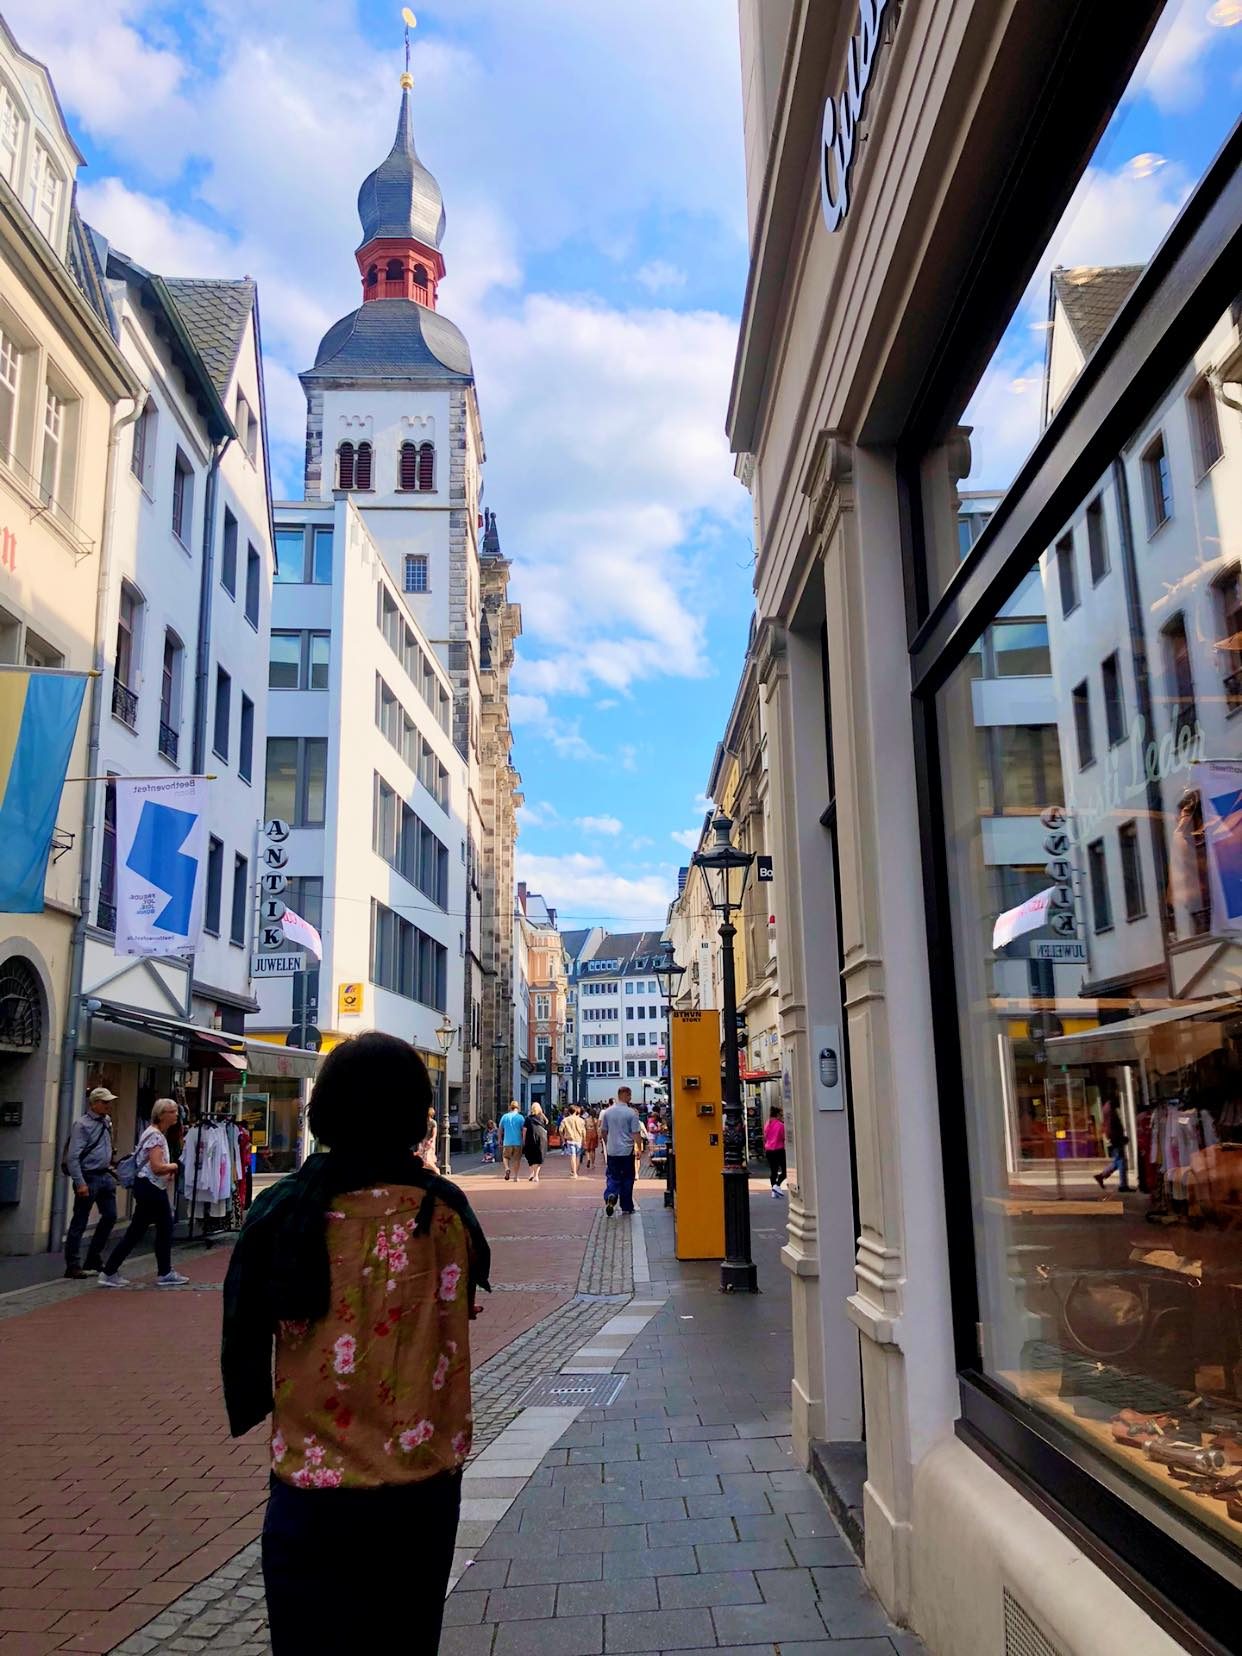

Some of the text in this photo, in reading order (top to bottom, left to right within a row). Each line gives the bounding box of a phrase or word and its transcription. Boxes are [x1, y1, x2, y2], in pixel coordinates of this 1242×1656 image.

[1125, 704, 1206, 793] Leder
[263, 820, 287, 945] ANTIK
[255, 958, 301, 972] JUWELEN
